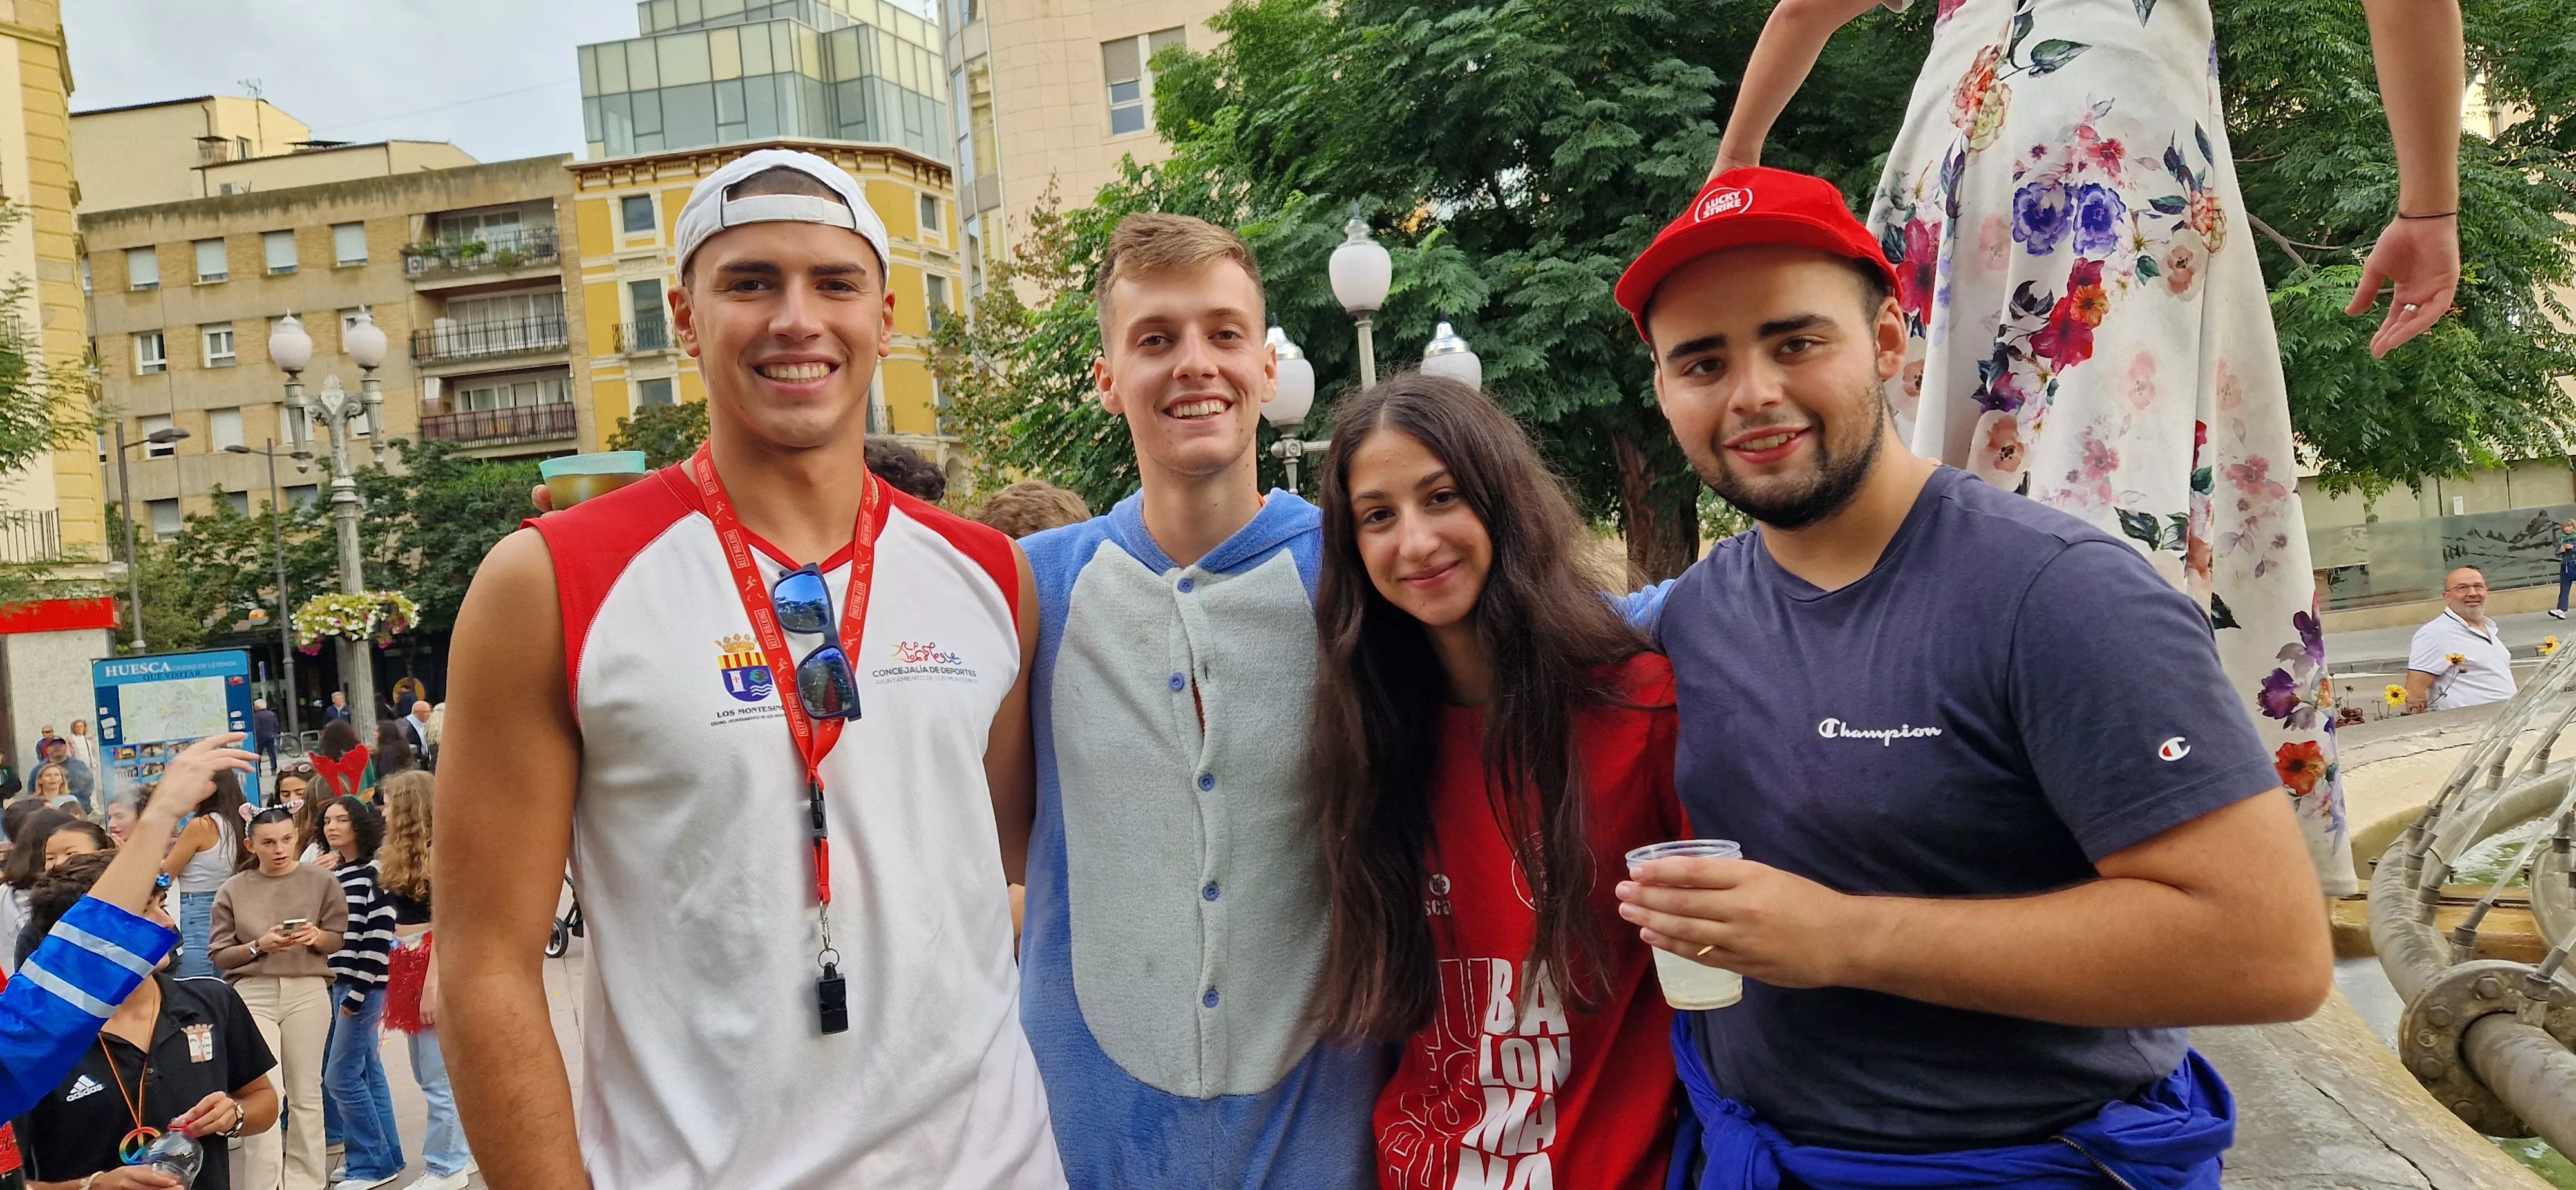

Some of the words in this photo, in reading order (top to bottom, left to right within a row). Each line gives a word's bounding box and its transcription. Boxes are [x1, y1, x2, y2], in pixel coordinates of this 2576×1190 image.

[1703, 198, 1741, 219] STRIKE
[1705, 191, 1741, 211] LUCKY
[855, 582, 864, 596] KEEP
[758, 610, 773, 635] WALKING
[766, 634, 779, 648] KEEP
[104, 661, 171, 677] HUESCA
[873, 664, 929, 677] CONCEJALÍA
[940, 666, 977, 677] DEPORTES
[716, 710, 735, 718] LOS
[789, 695, 802, 721] WALKING
[796, 720, 806, 735] KEEP
[1818, 717, 1942, 746] Champion
[66, 1083, 105, 1102] adidas
